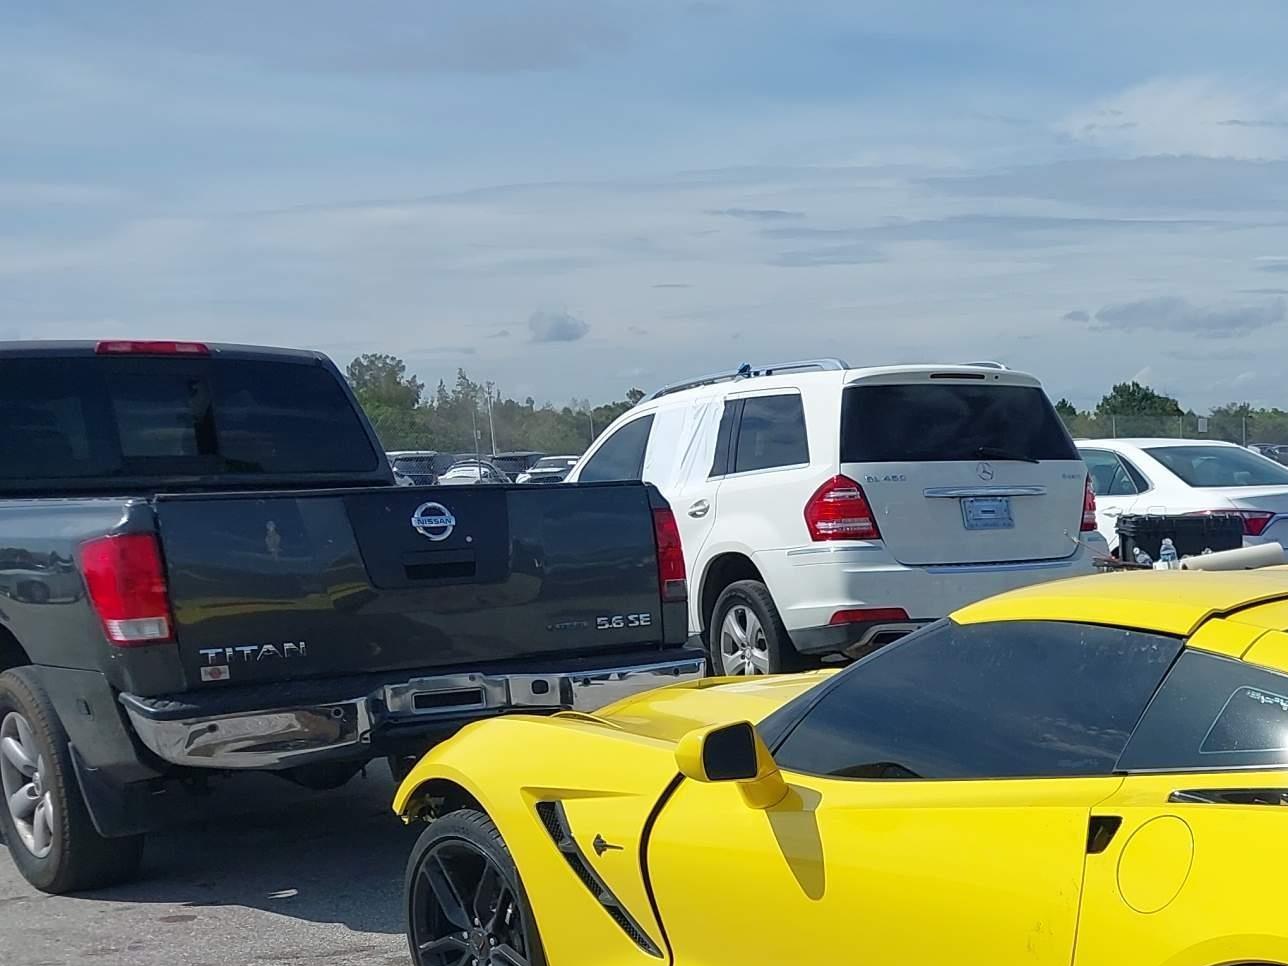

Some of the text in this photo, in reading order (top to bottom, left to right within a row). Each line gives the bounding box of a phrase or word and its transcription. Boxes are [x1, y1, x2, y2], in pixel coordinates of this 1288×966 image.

[596, 615, 625, 629] 5.6
[627, 613, 651, 626] SE
[199, 641, 306, 664] TITAN
